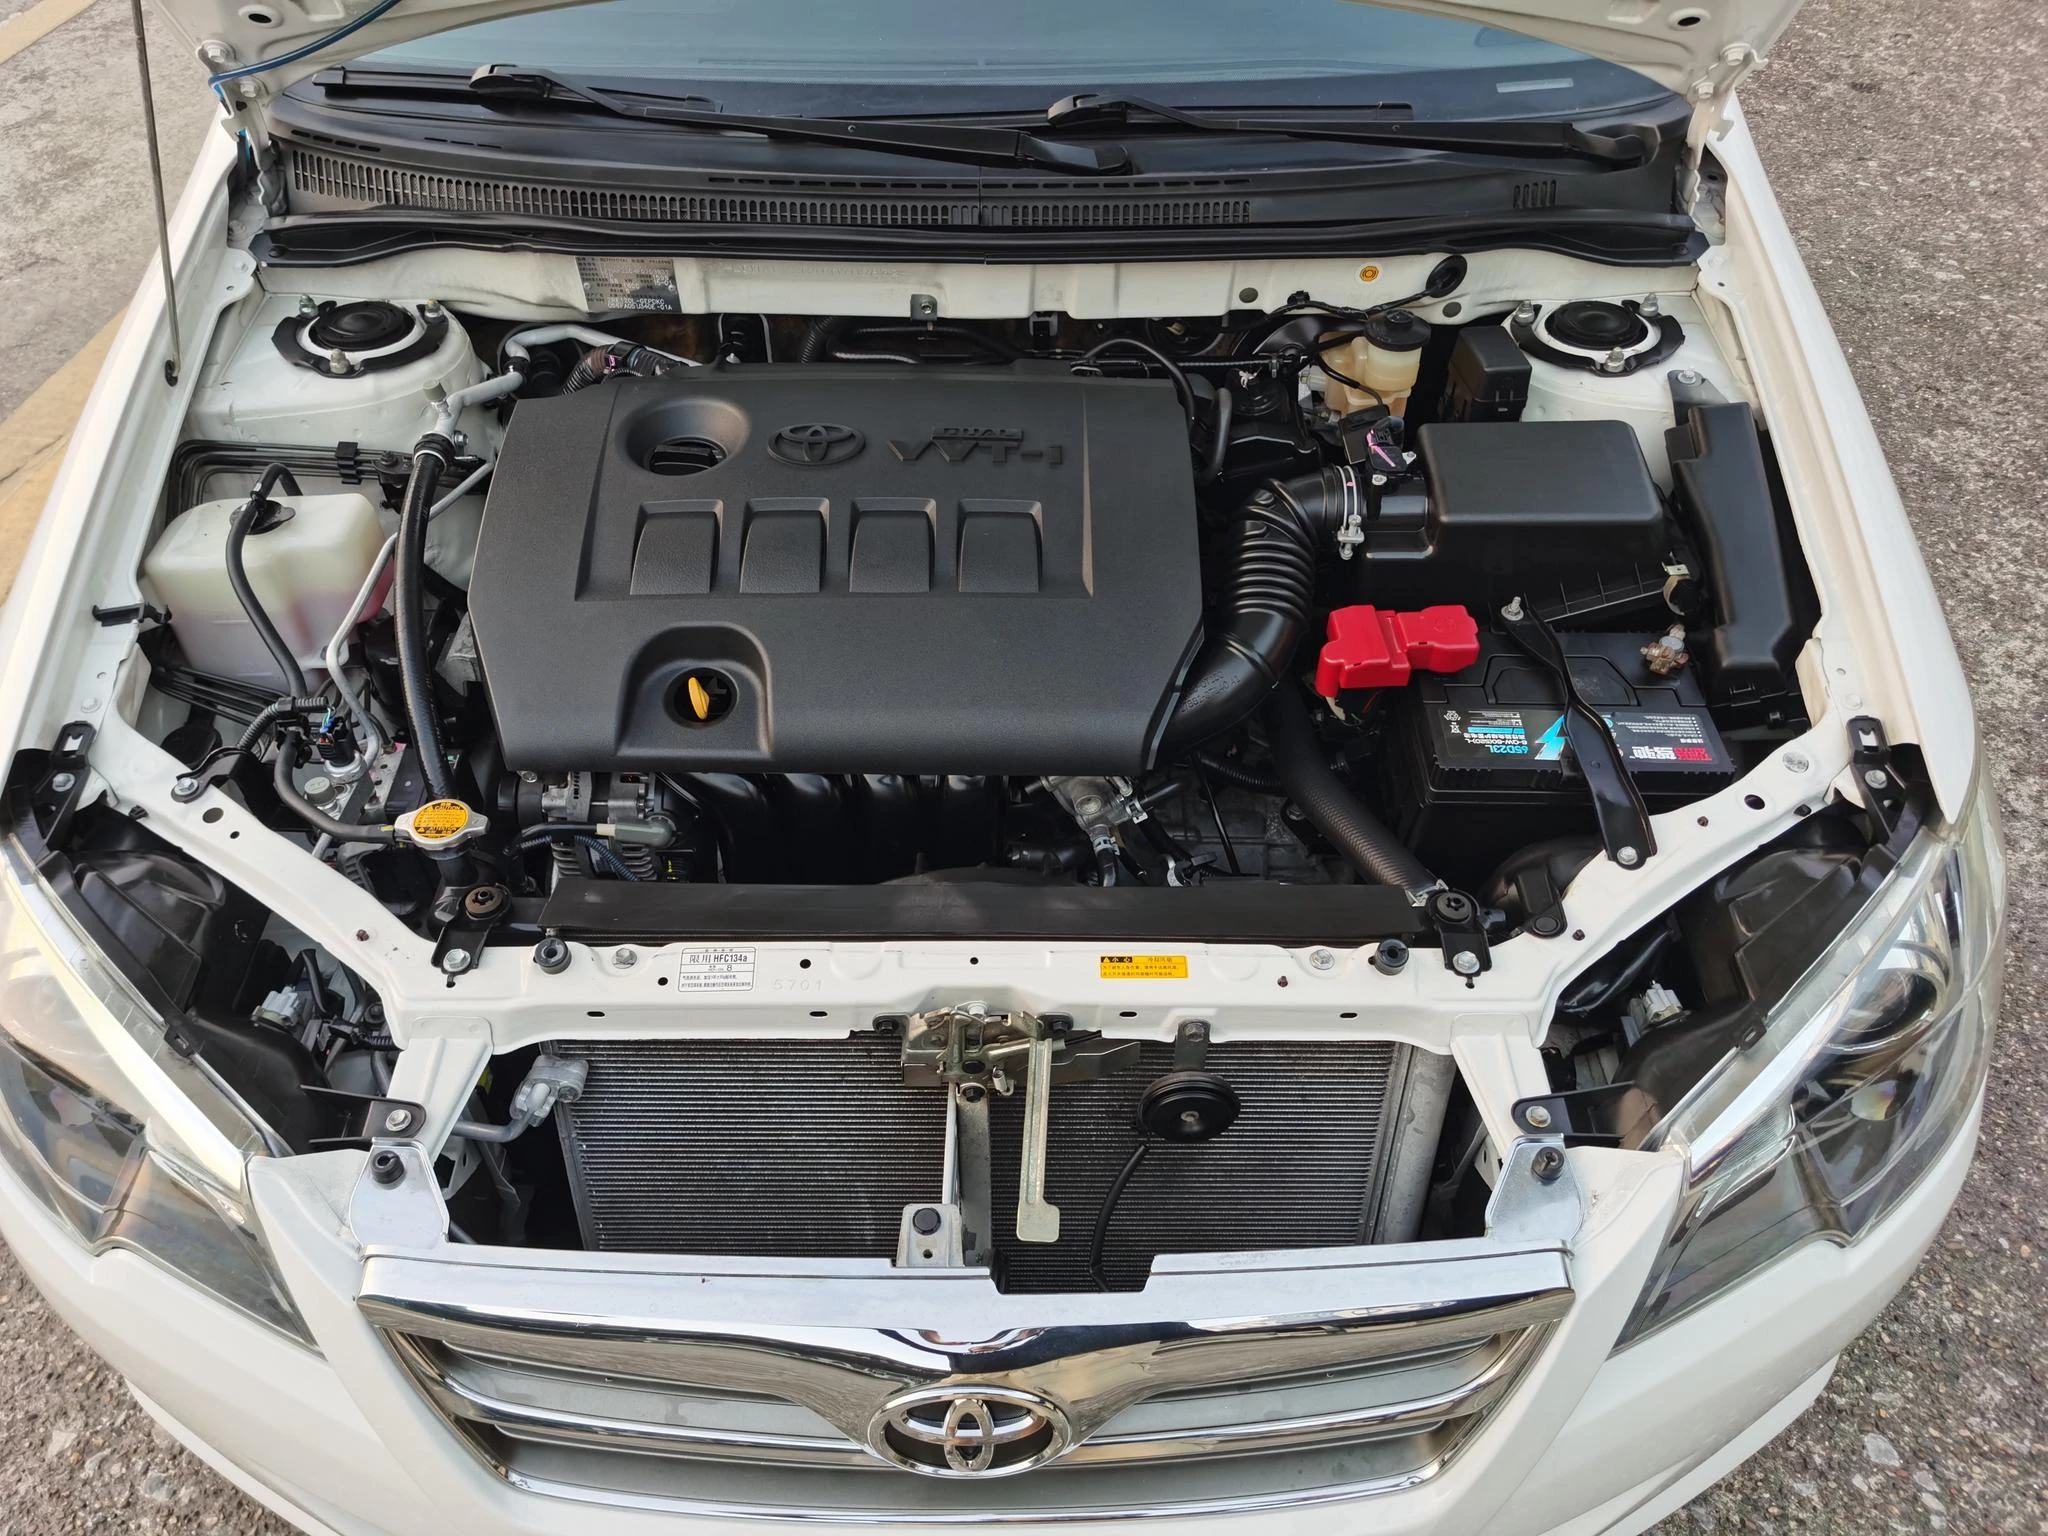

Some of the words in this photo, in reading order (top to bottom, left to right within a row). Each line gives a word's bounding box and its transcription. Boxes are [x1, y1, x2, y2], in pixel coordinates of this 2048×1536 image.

[939, 427, 1020, 439] DUAL
[1485, 745, 1528, 754] 65D23L
[713, 953, 748, 963] HFC134a
[772, 979, 823, 991] 5701
